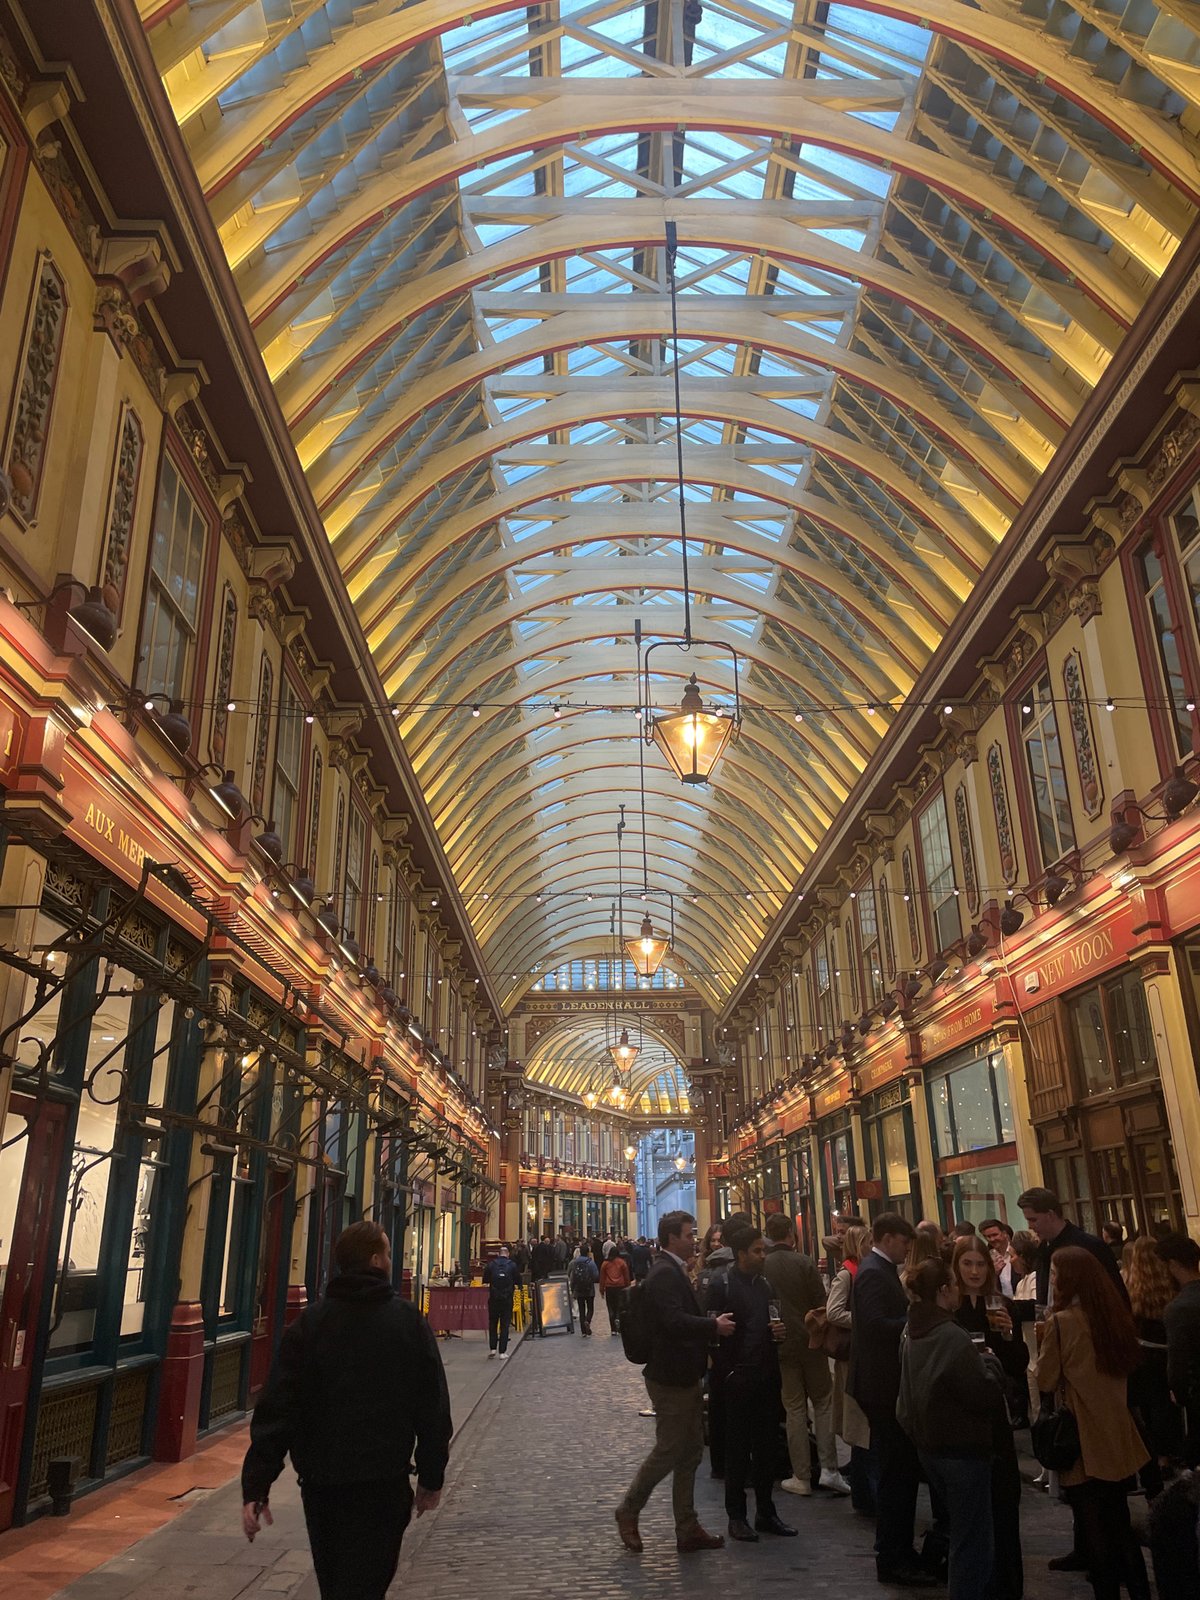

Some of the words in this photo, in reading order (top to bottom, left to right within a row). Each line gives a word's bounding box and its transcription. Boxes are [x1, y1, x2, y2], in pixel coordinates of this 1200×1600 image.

[85, 802, 116, 844] AUX
[1039, 954, 1066, 988] NEW
[1069, 928, 1114, 974] MOON
[561, 1001, 650, 1010] LEADENHALL
[947, 1018, 964, 1038] FROM
[964, 1008, 982, 1028] HOME
